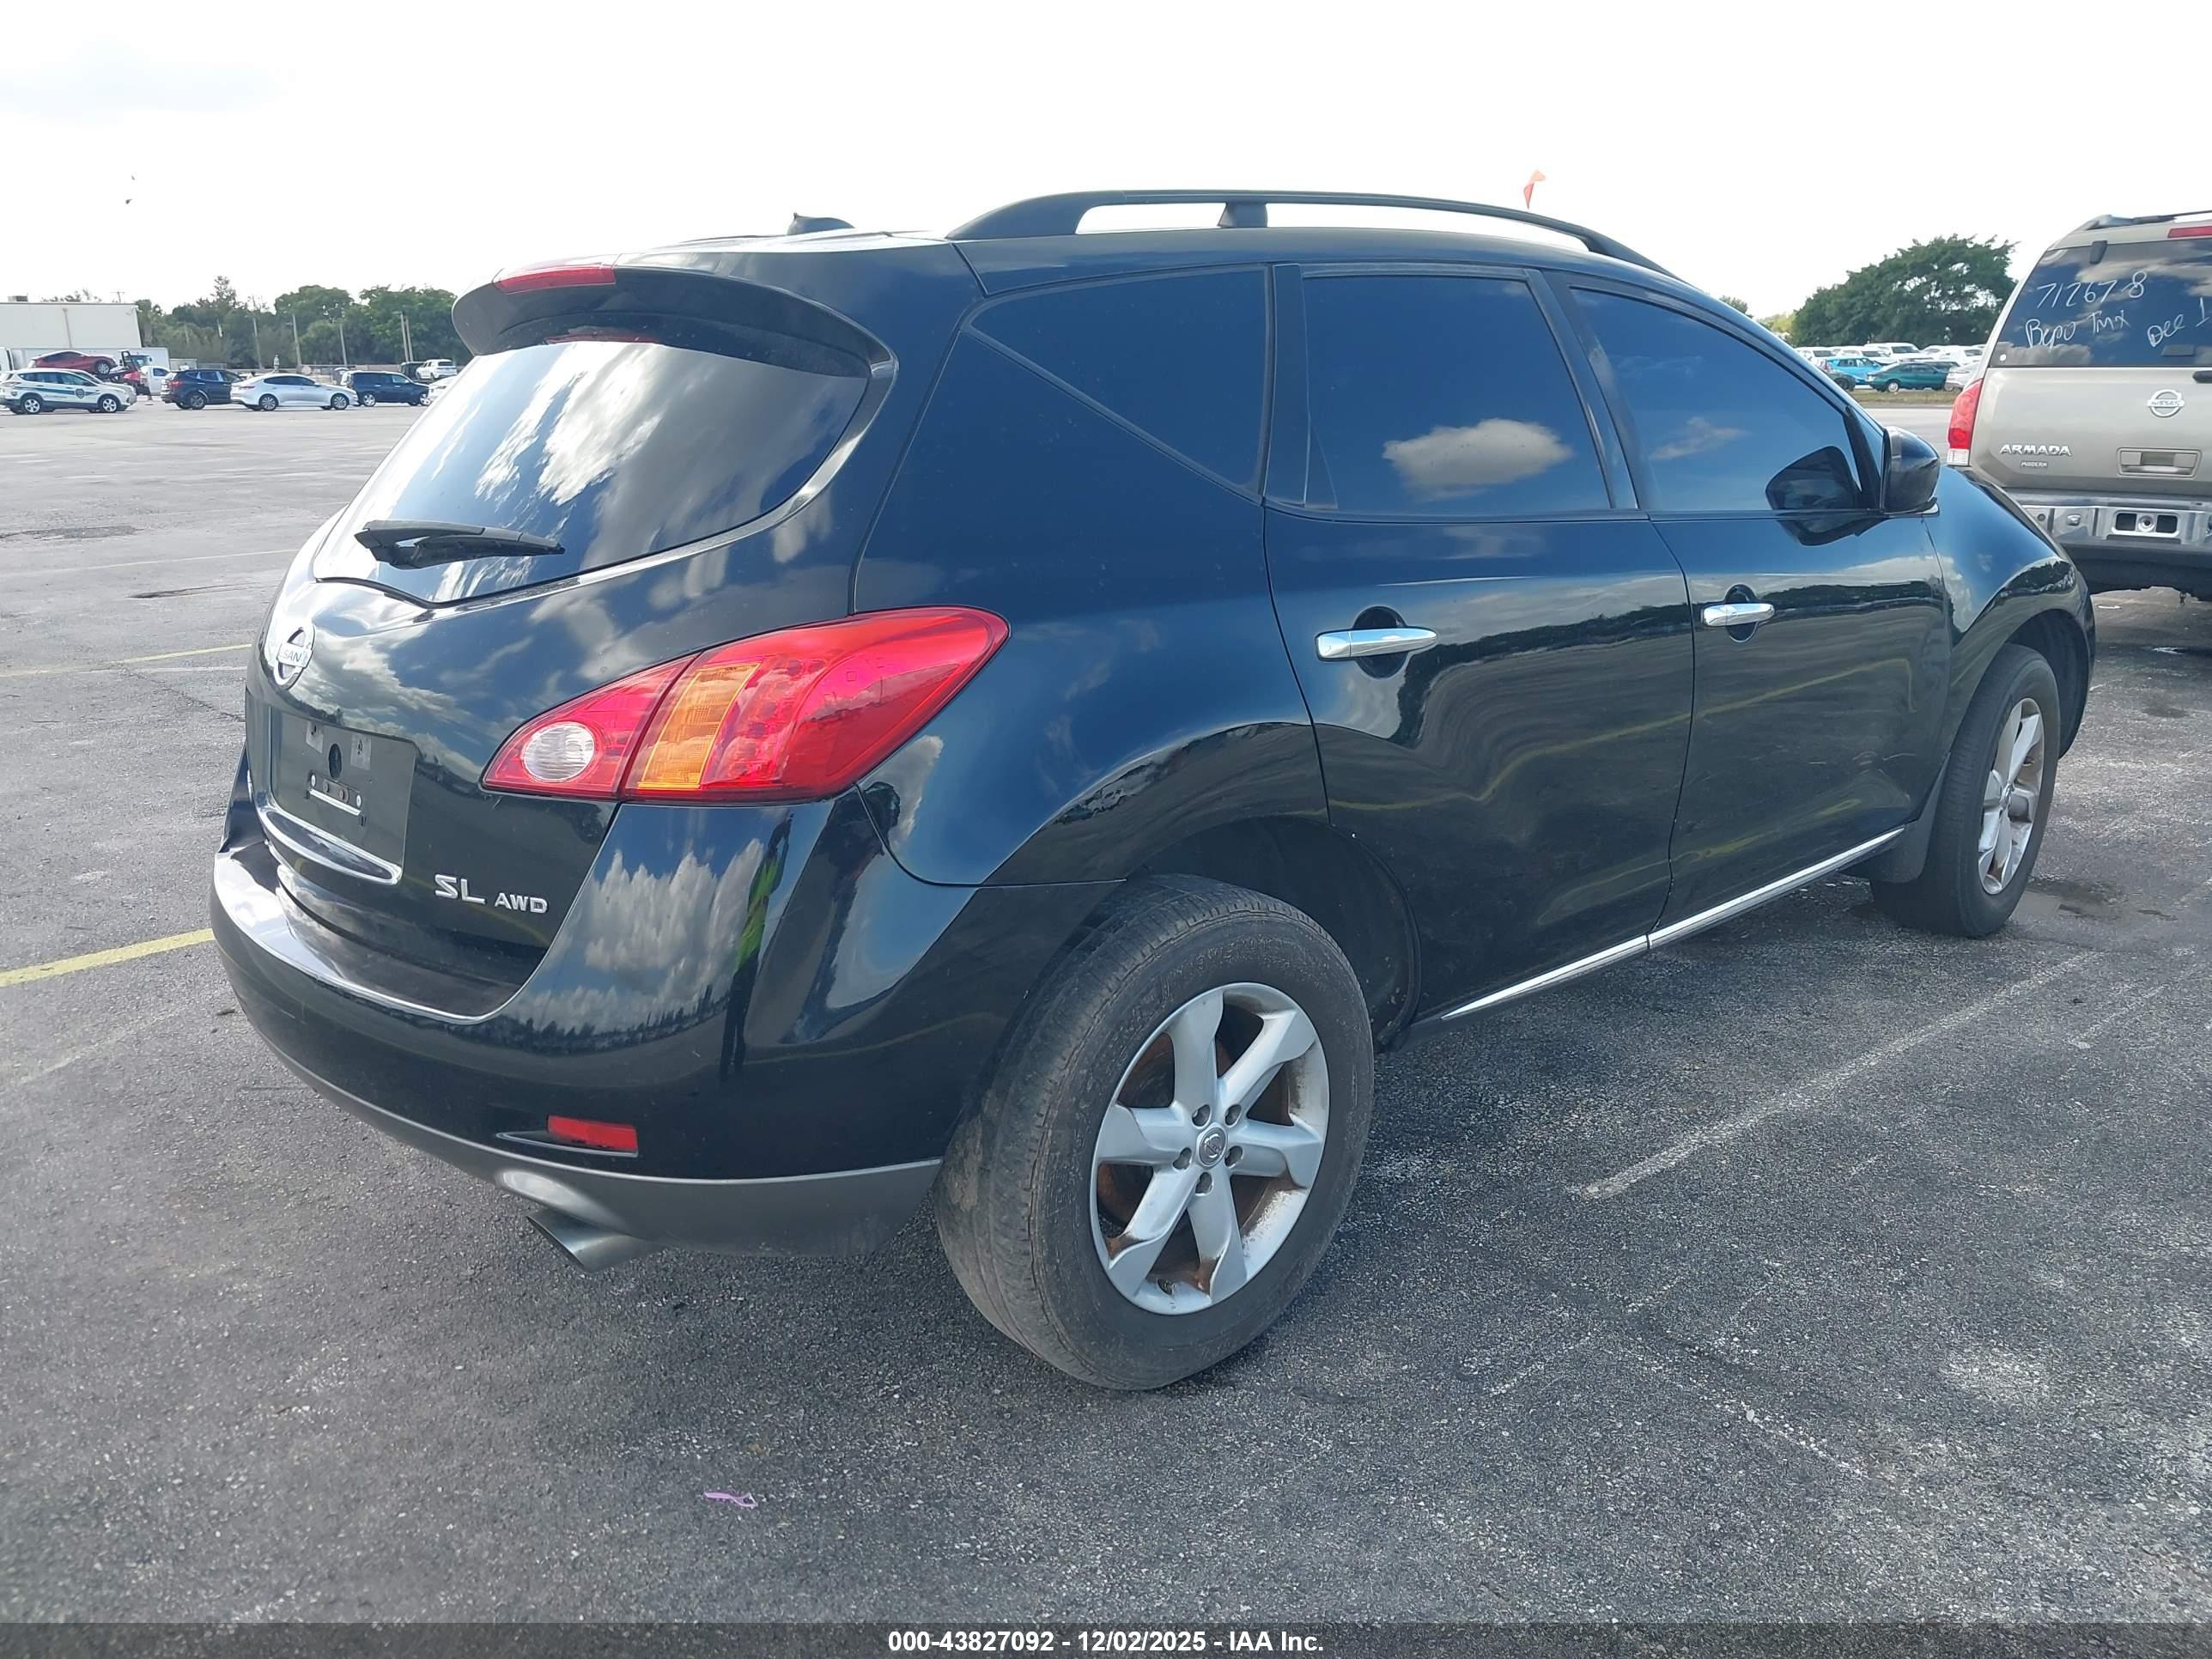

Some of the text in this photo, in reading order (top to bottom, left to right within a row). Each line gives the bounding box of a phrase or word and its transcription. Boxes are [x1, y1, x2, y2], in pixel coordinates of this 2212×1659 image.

[1999, 444, 2072, 456] ARMADA
[434, 873, 548, 914] SL AWD
